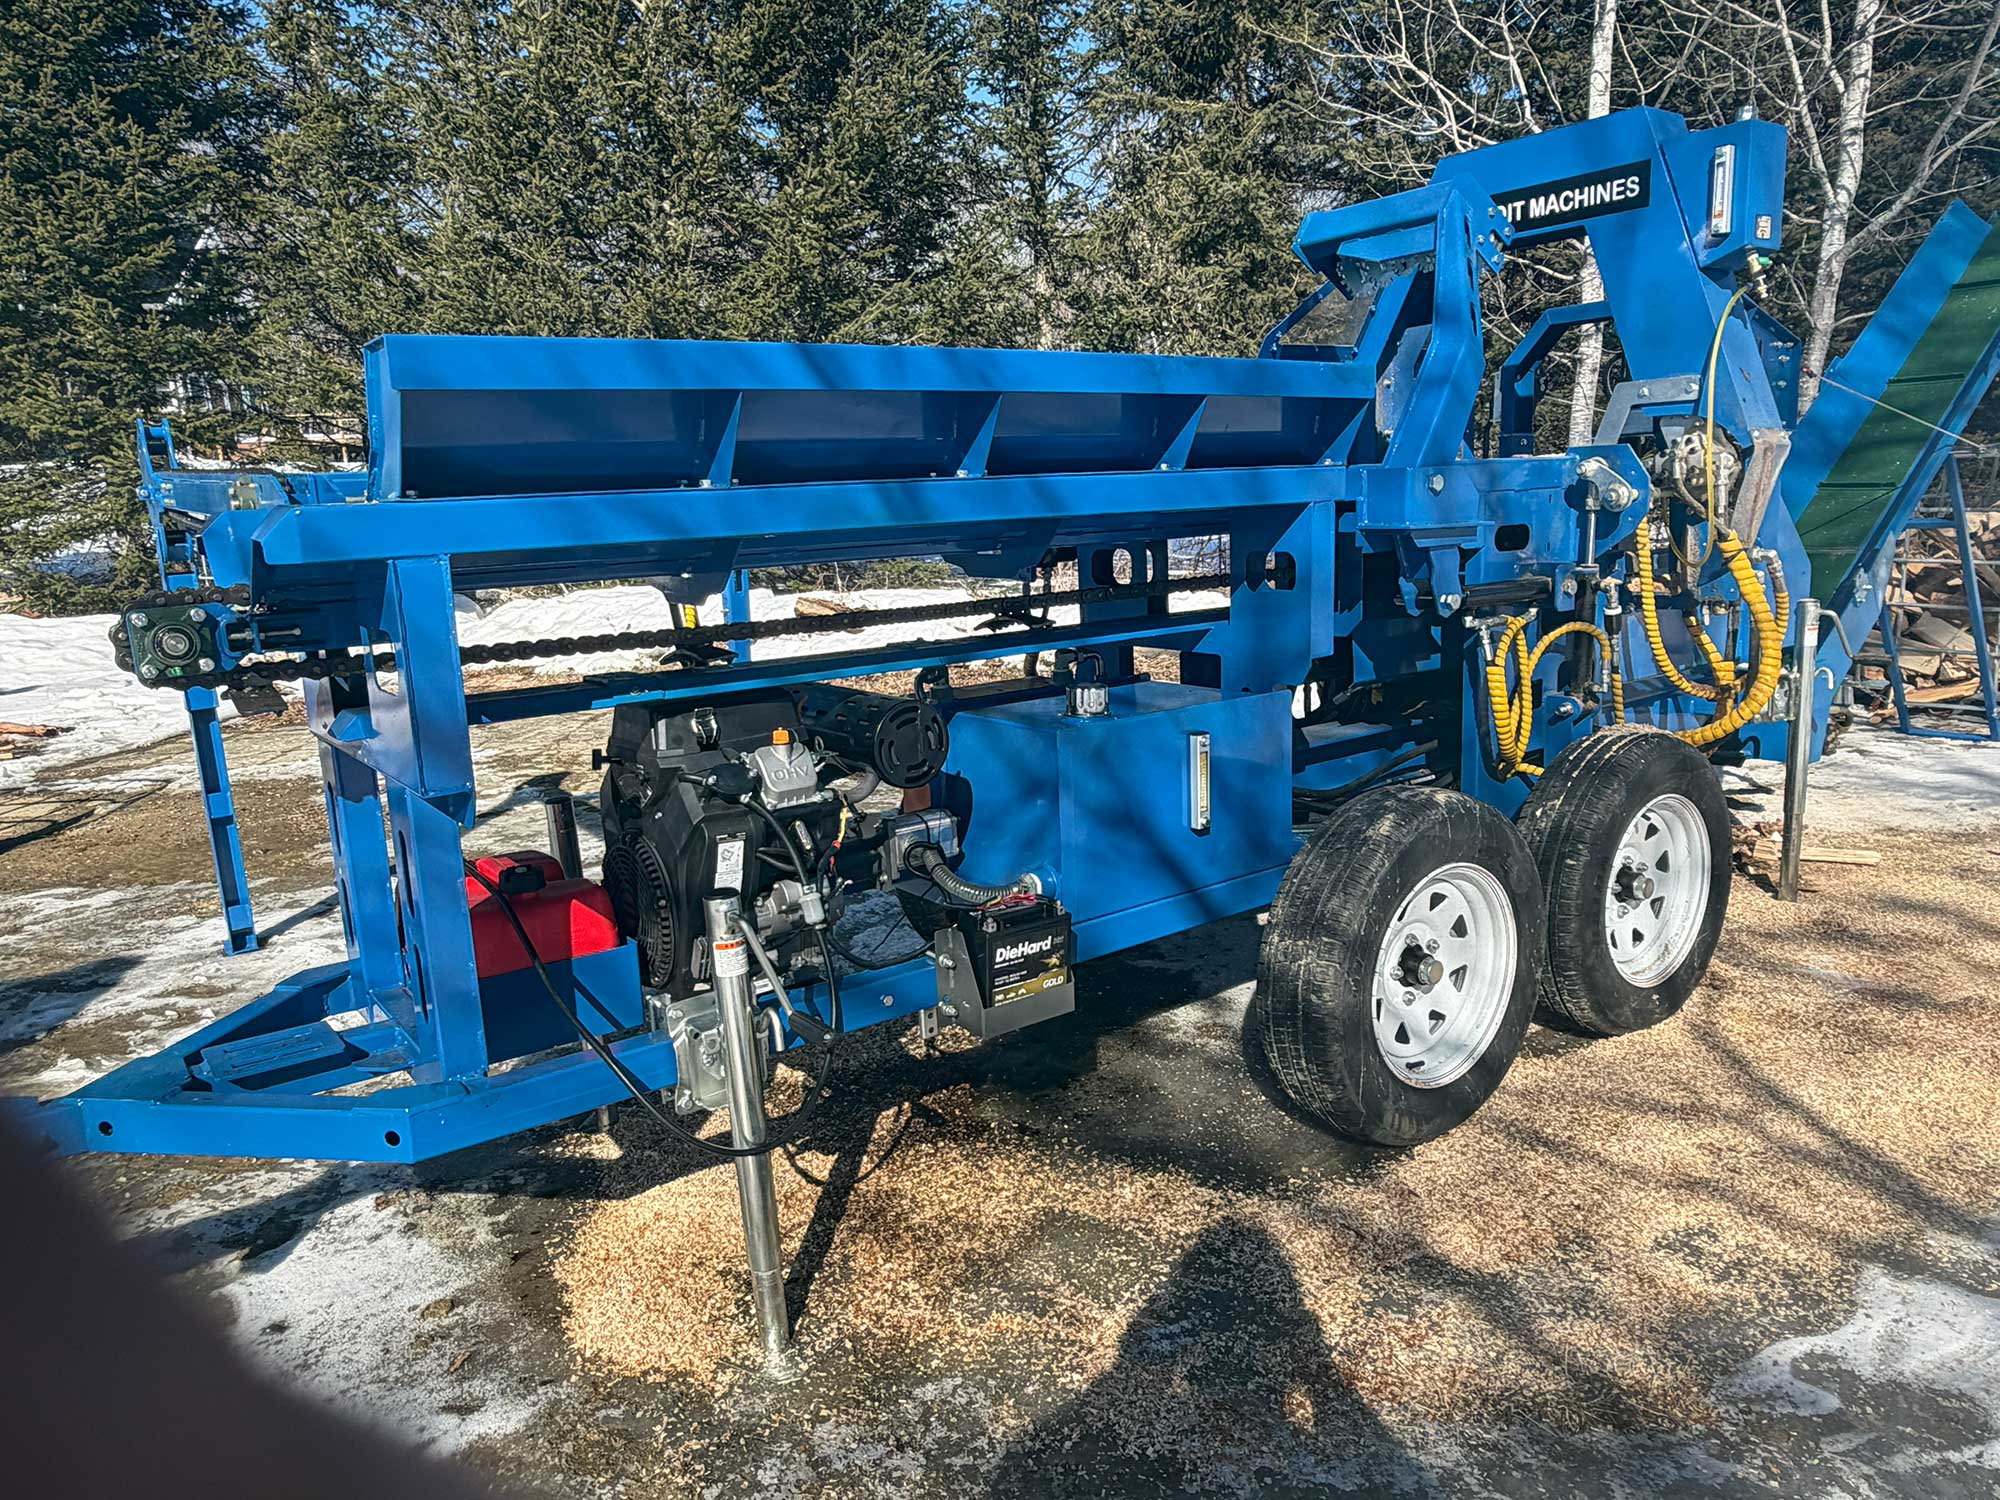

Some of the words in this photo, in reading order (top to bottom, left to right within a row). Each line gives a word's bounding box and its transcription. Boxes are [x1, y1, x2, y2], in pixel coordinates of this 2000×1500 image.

[1529, 176, 1640, 218] MACHINES
[771, 765, 809, 781] OHV
[995, 935, 1052, 963] DieHard
[1043, 975, 1064, 989] GOLD
